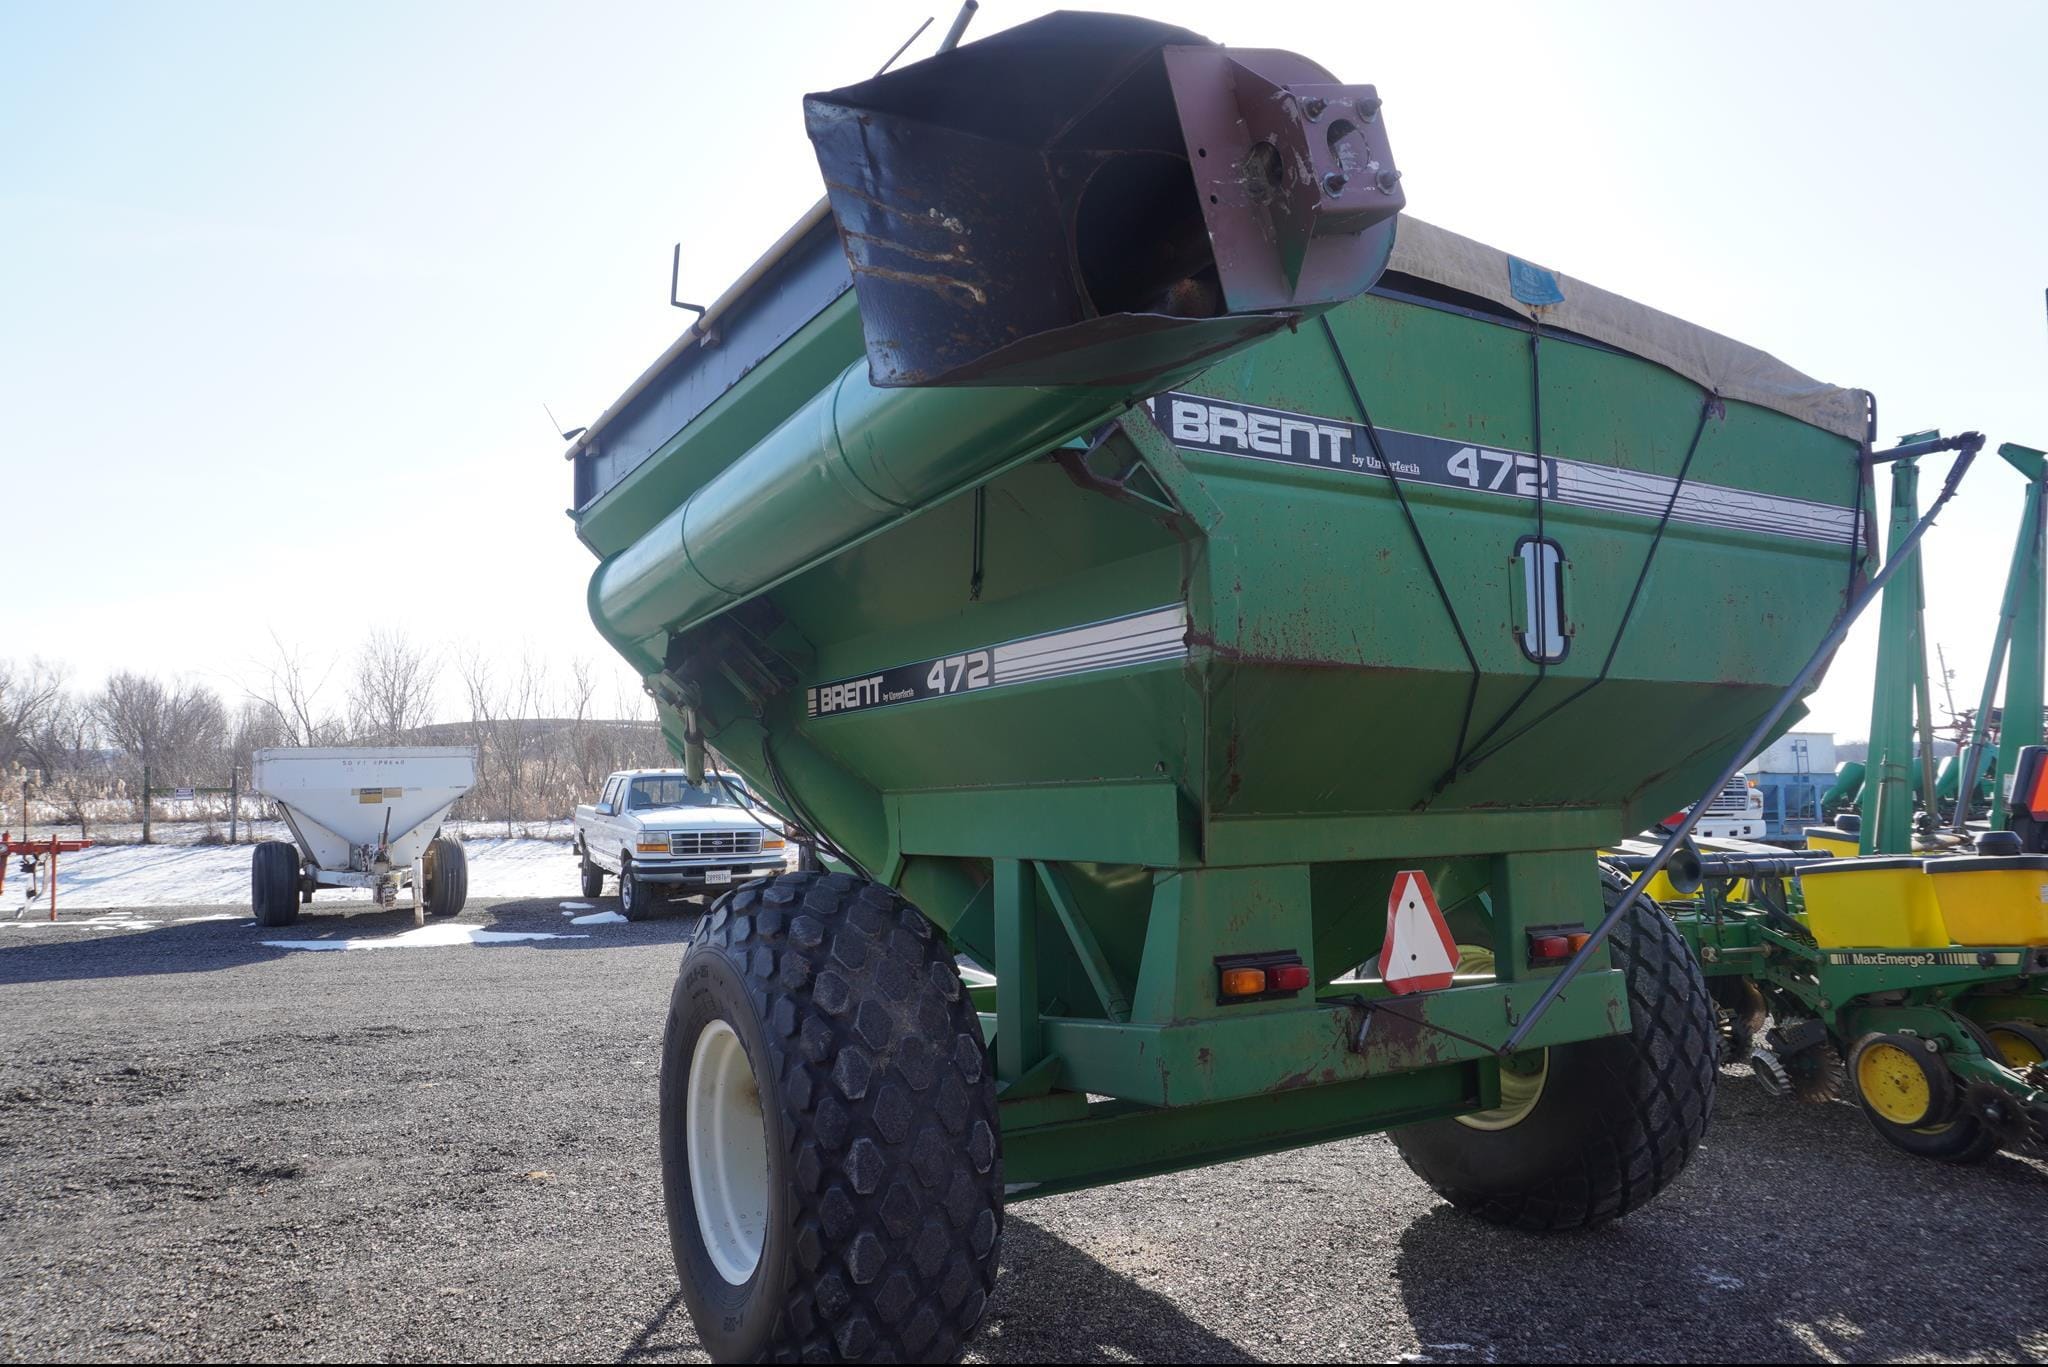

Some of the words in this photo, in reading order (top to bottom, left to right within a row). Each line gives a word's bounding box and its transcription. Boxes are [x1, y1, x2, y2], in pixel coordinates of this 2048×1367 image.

[1172, 399, 1352, 463] BRENT
[1352, 454, 1364, 467] by
[1366, 455, 1420, 475] Unrferth
[1447, 447, 1549, 498] 472
[821, 675, 884, 713] BRENT
[926, 650, 989, 694] 472
[1853, 954, 1926, 967] MaxEmerge
[1927, 953, 1935, 965] 2
